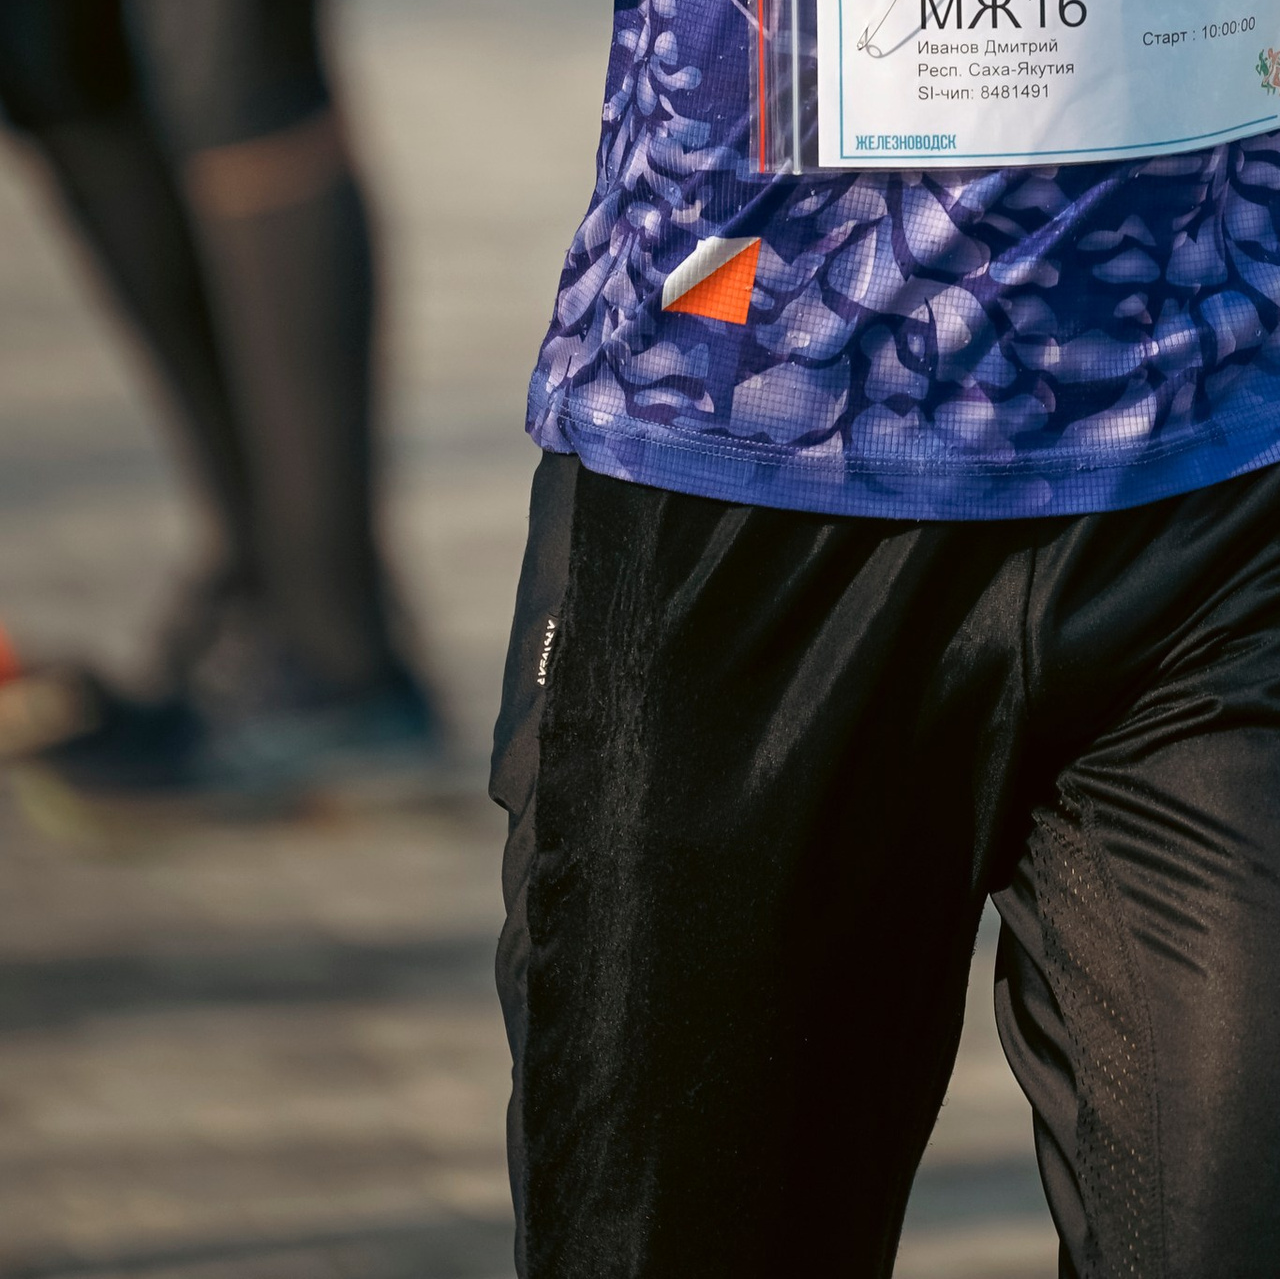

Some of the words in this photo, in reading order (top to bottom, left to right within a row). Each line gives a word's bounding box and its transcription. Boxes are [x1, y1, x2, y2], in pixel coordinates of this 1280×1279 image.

[1142, 31, 1188, 47] Старт
[1201, 17, 1257, 40] 10:00:00
[917, 41, 979, 55] Иванов
[984, 39, 1059, 57] Дмитрий
[918, 63, 962, 78] Респ.
[968, 61, 1075, 79] Саха-Якутия
[918, 86, 974, 101] SI-чип:
[980, 84, 1050, 100] 8481491
[855, 134, 957, 151] ЖЕЛЕЗНОВОДСК
